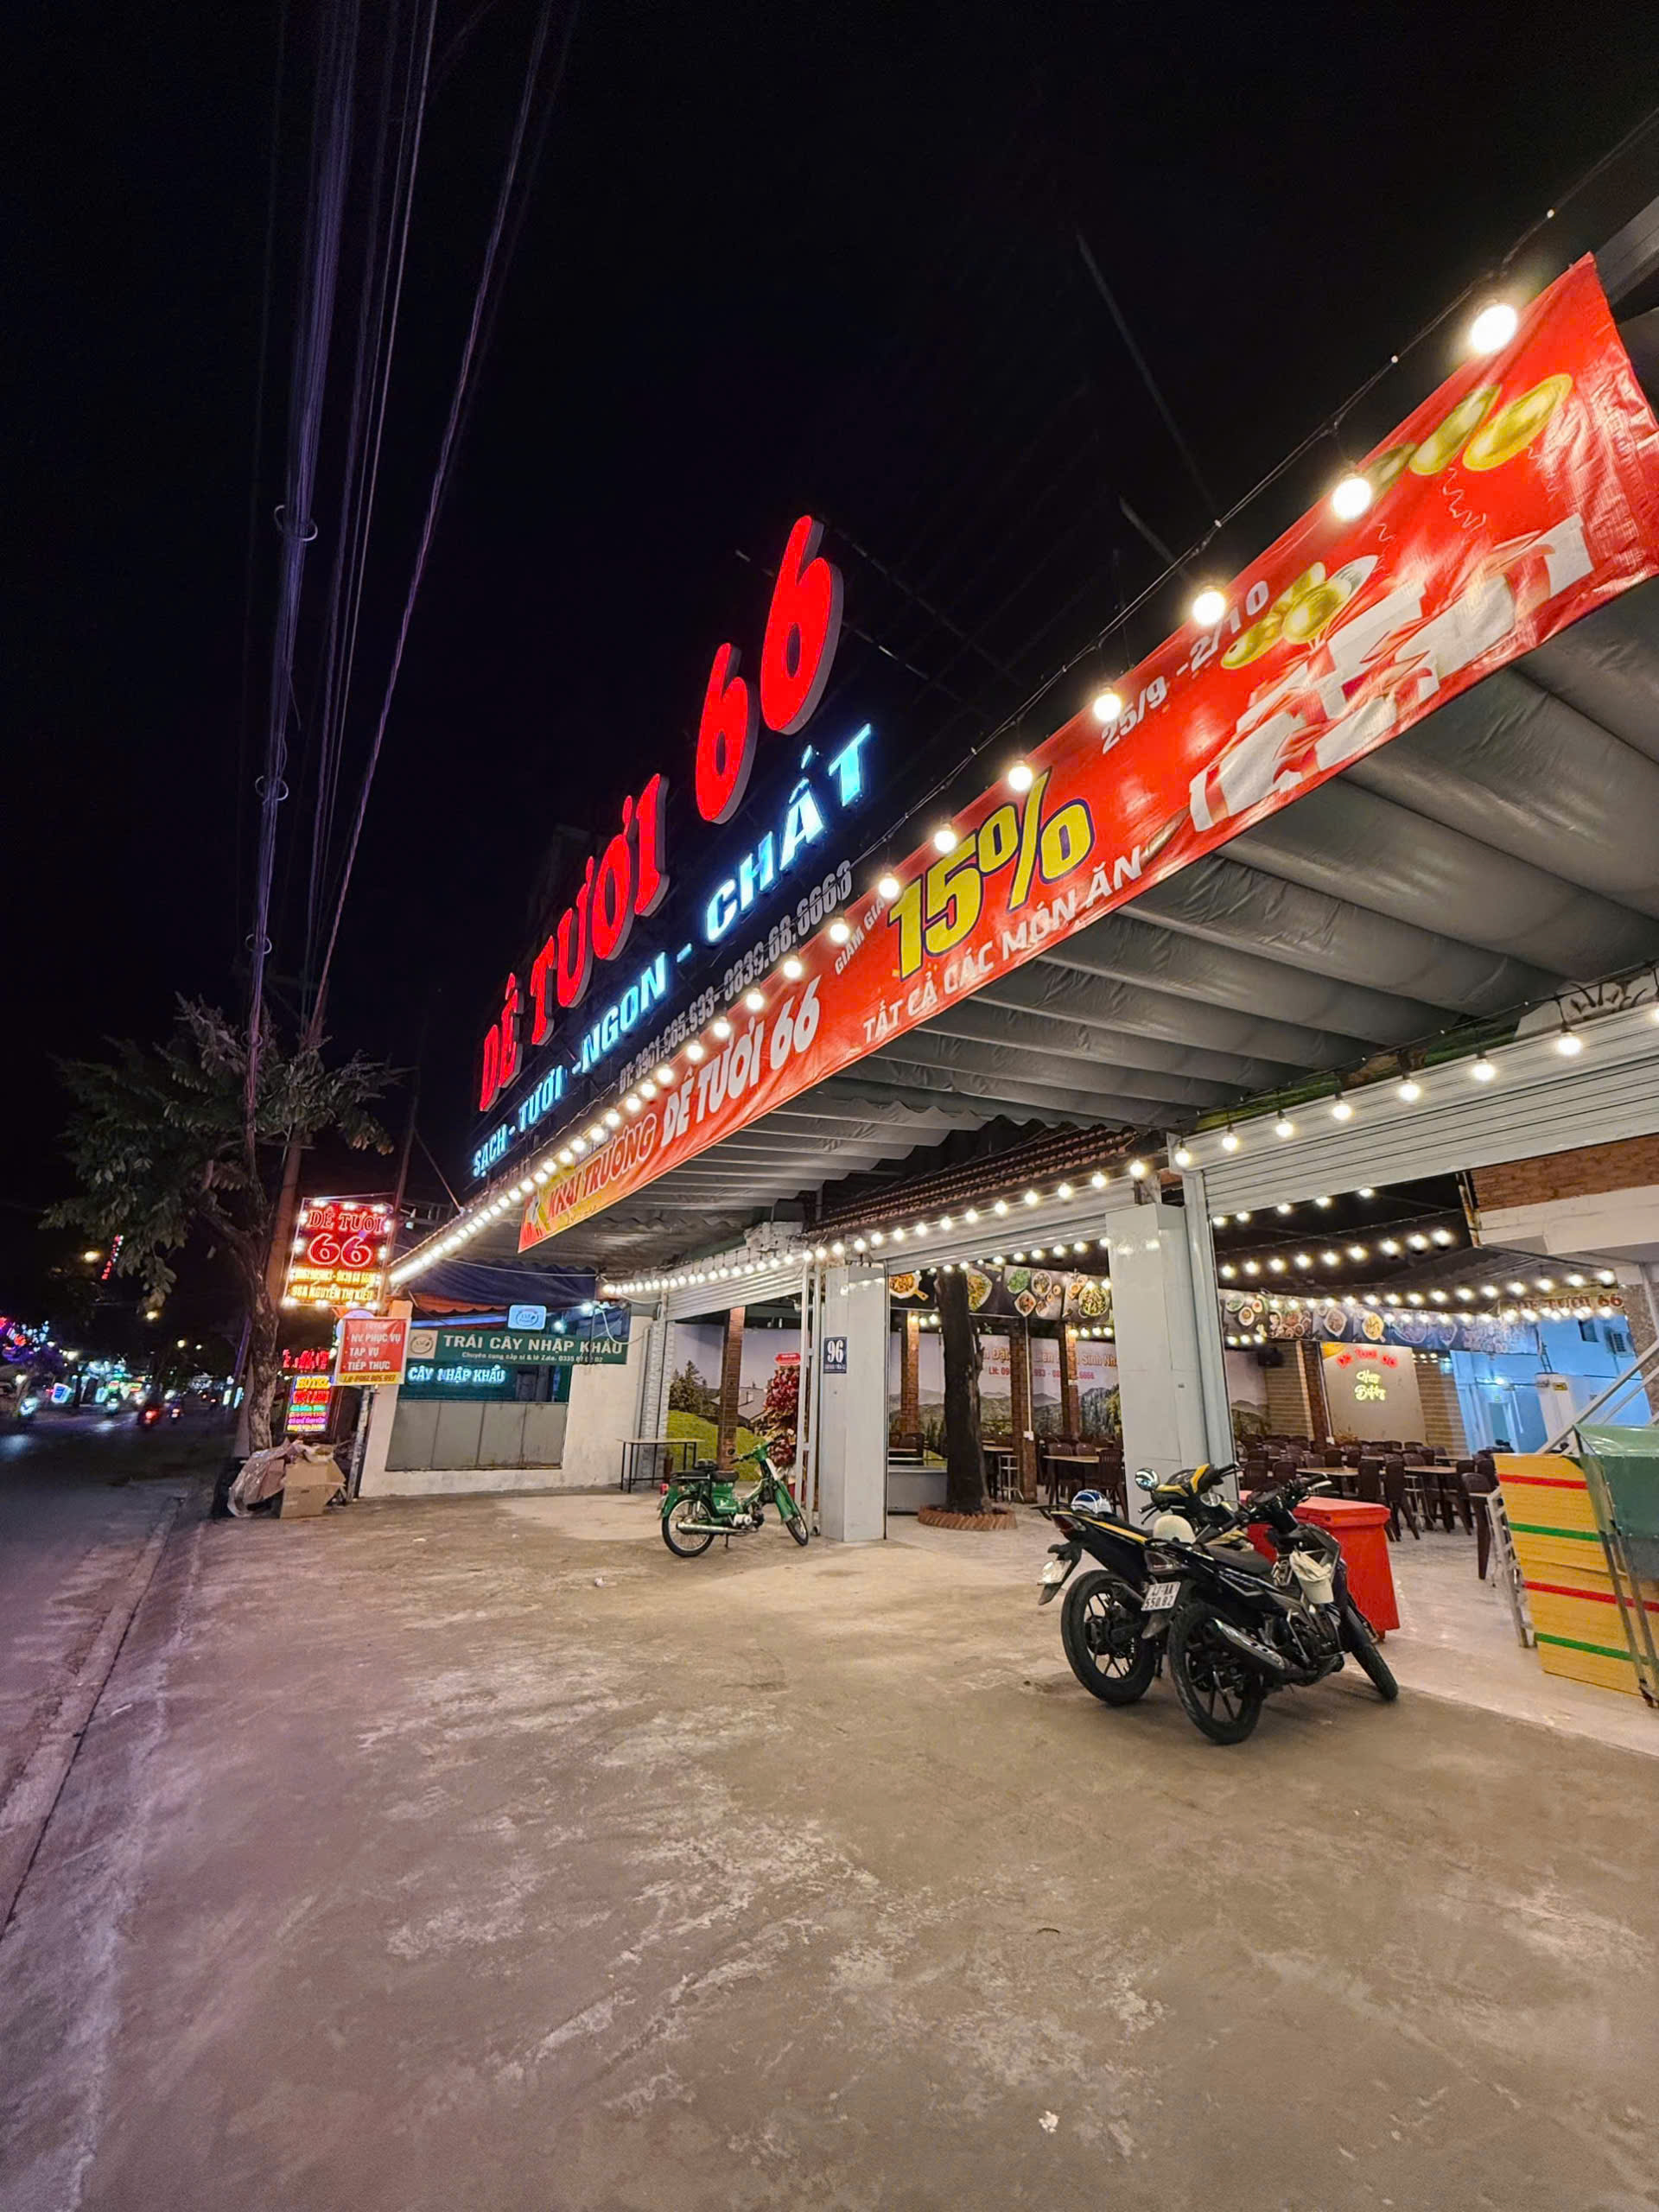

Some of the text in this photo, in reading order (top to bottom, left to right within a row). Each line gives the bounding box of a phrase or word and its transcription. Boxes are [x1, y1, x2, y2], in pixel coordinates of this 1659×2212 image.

[1102, 676, 1166, 753] 25/9
[480, 515, 843, 1111] DÊ TƯƠI 66
[887, 766, 1095, 982] 15%
[473, 1123, 508, 1178] SẠCH
[705, 722, 872, 943] CHẤT
[863, 845, 1142, 1045] TẤT CẢ CÁC MÓN ĂN
[661, 1065, 695, 1147] DÊ
[696, 1016, 766, 1123] TƯƠI
[771, 975, 821, 1071] 66
[307, 1205, 386, 1235] DÊ TƯƠI
[308, 1232, 372, 1268] 66
[1597, 1293, 1624, 1306] 66
[349, 1347, 380, 1358] TẠP VỤ
[365, 1332, 387, 1344] PHỤC
[390, 1333, 402, 1345] VỤ
[443, 1333, 482, 1349] TRÁI
[489, 1337, 525, 1350] CÂY
[528, 1338, 575, 1353] NHẬP
[580, 1339, 623, 1355] KHẨU
[827, 1339, 844, 1363] 96
[347, 1359, 367, 1371] TIẾP
[407, 1364, 505, 1383] CÂY NHẬP KHẨU
